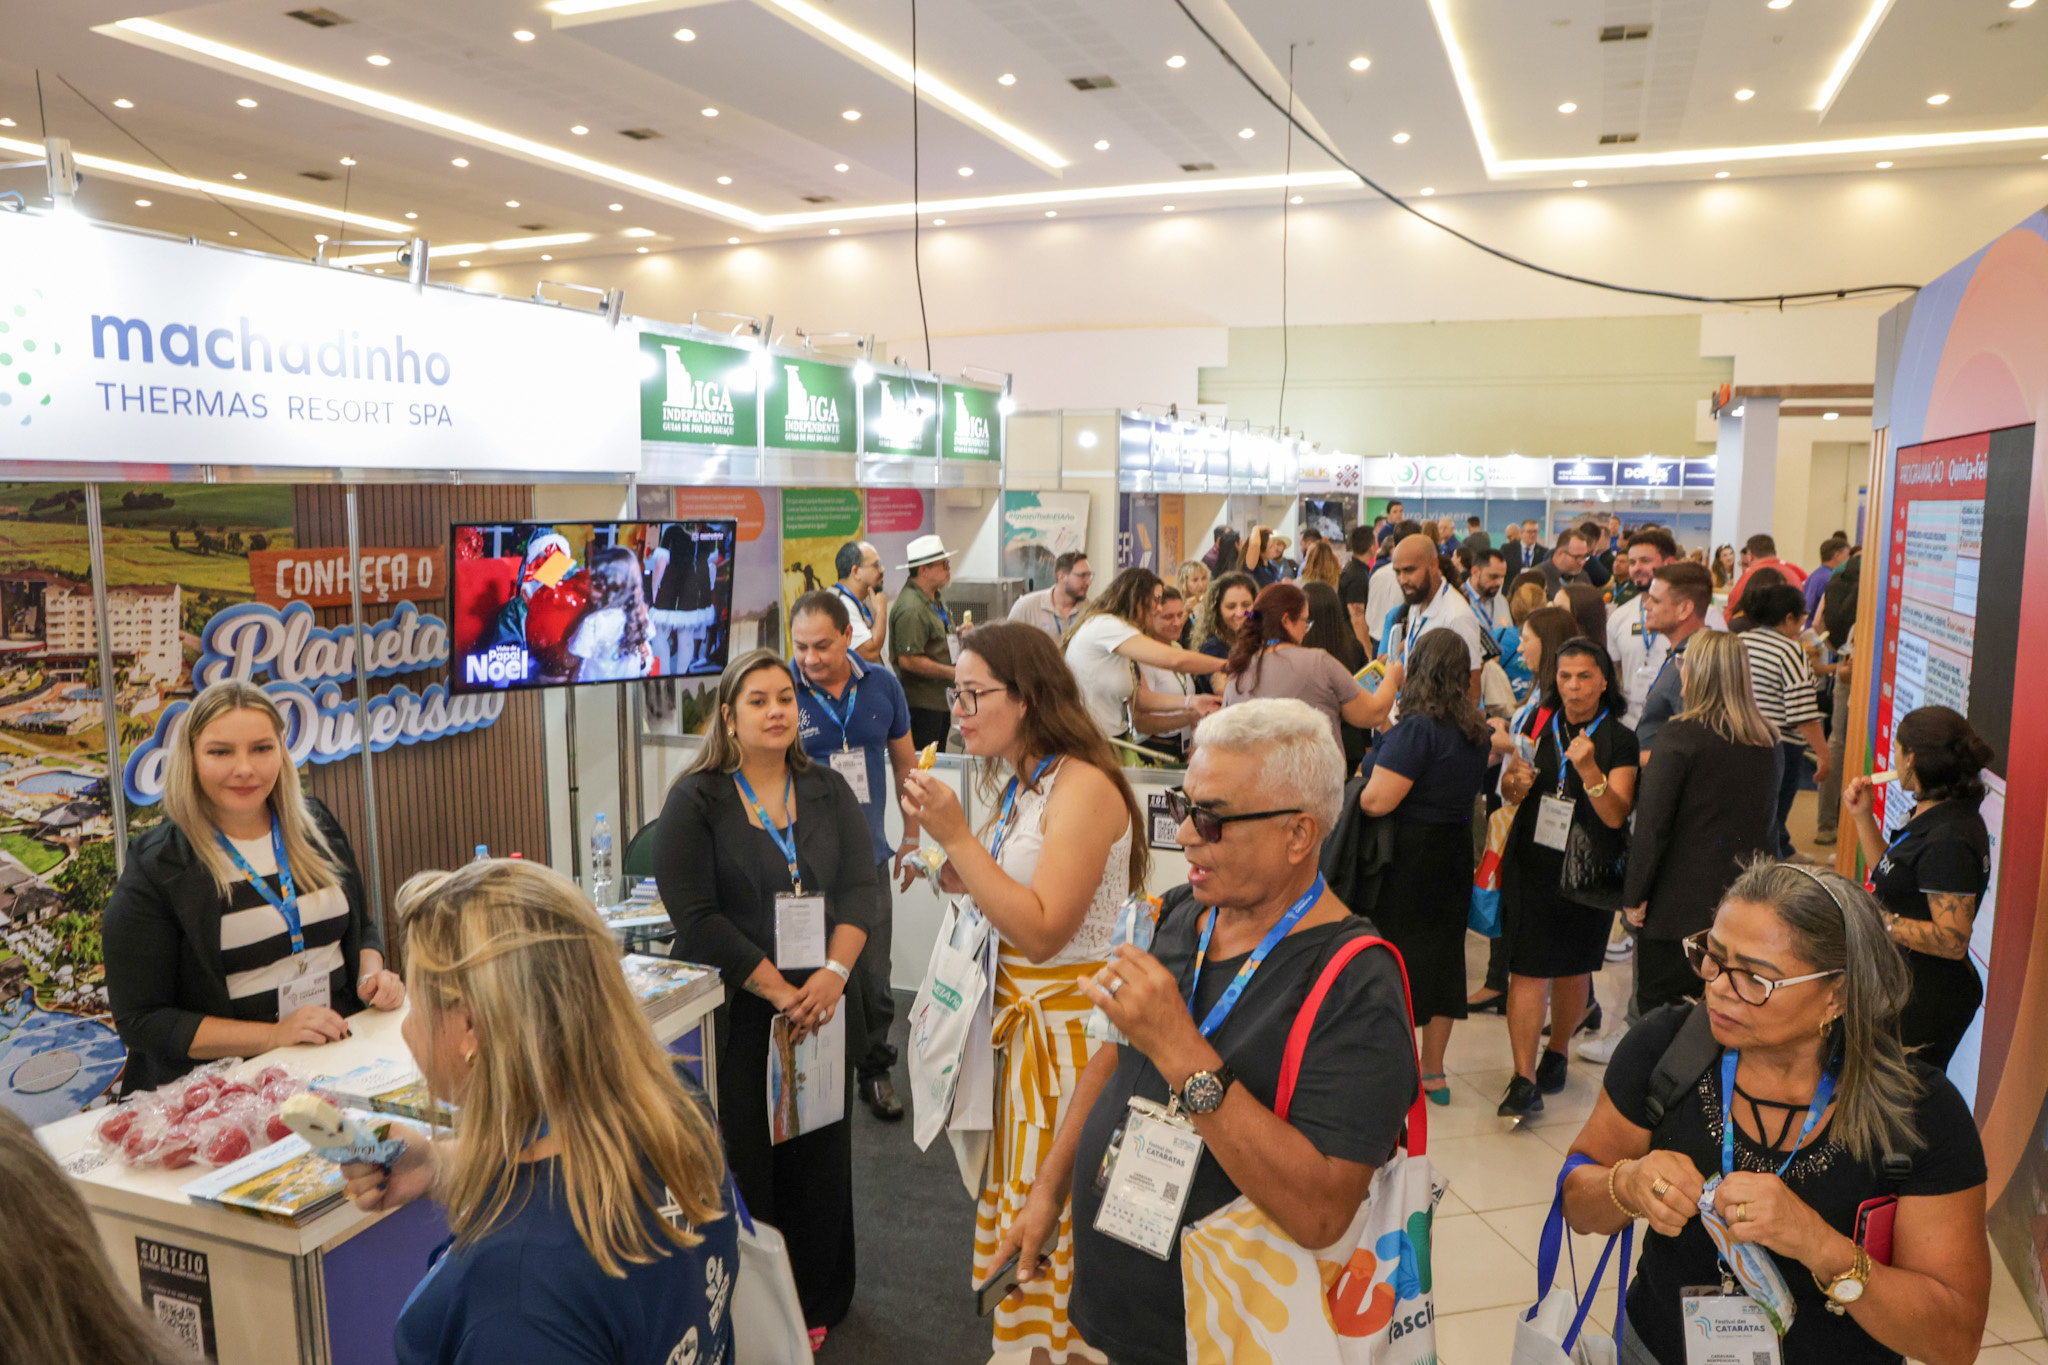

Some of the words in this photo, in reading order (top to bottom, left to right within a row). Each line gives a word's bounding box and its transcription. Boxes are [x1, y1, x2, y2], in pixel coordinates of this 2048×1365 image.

[91, 314, 450, 386] machadinho
[96, 381, 268, 419] THERMAS
[288, 396, 394, 424] RESORT
[409, 404, 452, 427] SPA
[663, 407, 734, 426] INDEPENDENTE
[663, 421, 681, 432] GUIAS
[682, 423, 690, 433] DE
[691, 423, 703, 433] FOZ
[703, 424, 713, 434] DO
[785, 419, 840, 434] INDEPENDENTE
[1900, 456, 1944, 488] PROGRAMAÇÃO
[276, 553, 409, 603] CONHEÇA
[417, 555, 434, 589] O
[203, 611, 450, 685] Planeta
[489, 647, 521, 664] Papai
[466, 650, 529, 684] Noel
[1146, 1147, 1185, 1168] CATARATAS
[141, 1241, 204, 1274] SORTEIO
[1715, 1325, 1766, 1333] CATARATAS
